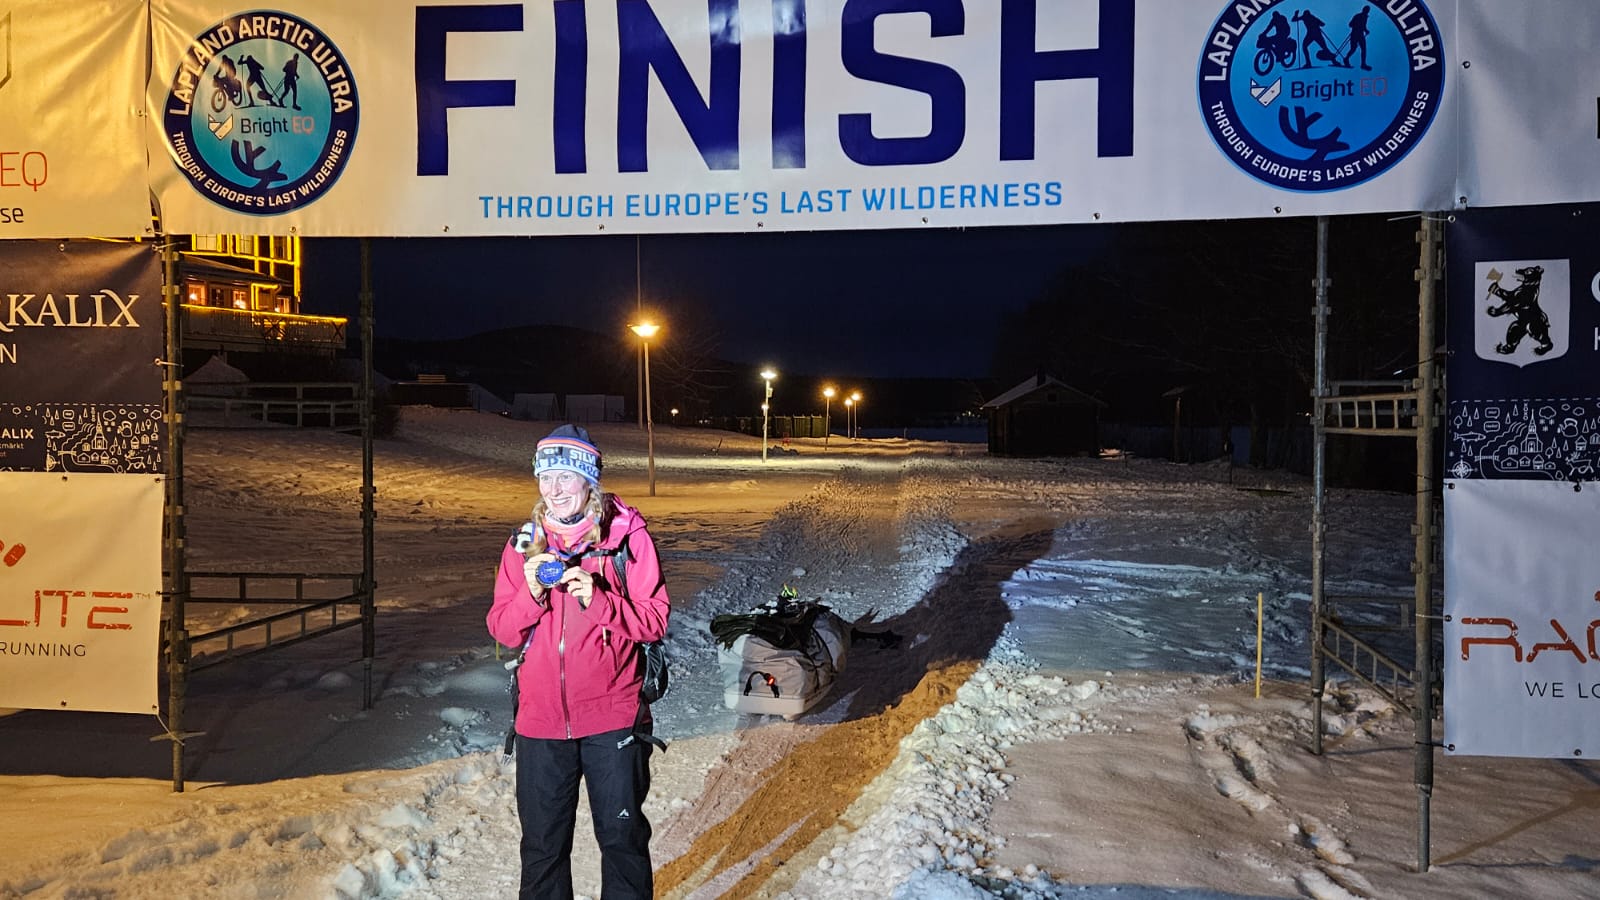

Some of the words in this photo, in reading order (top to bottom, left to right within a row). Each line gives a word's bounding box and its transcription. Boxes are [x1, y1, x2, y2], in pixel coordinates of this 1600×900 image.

[1204, 0, 1271, 81] LAPLAN
[1386, 0, 1436, 71] ULTRA
[169, 25, 234, 116] LAPLAND
[238, 16, 315, 49] ARCTIC
[311, 41, 353, 113] ULTRA
[415, 0, 1134, 176] FINISH
[1291, 79, 1354, 101] Bright
[1359, 77, 1387, 96] EQ
[240, 117, 288, 137] Bright
[292, 116, 315, 135] EQ
[1211, 101, 1255, 160] THROUGH
[1251, 154, 1321, 182] EUROPE'S
[1326, 160, 1362, 181] LAST
[1363, 90, 1429, 167] WILDERNESS
[0, 151, 48, 192] EQ
[172, 131, 207, 181] THROUGH
[203, 179, 265, 207] EUROPE'S
[268, 190, 298, 207] LAST
[298, 130, 348, 196] WILDERNESS
[479, 195, 613, 218] THROUGH
[626, 192, 768, 217] EUROPE'S
[781, 189, 852, 213] LAST
[862, 181, 1062, 211] WILDERNESS
[0, 641, 86, 656] RUNNING
[1525, 682, 1564, 698] WE
